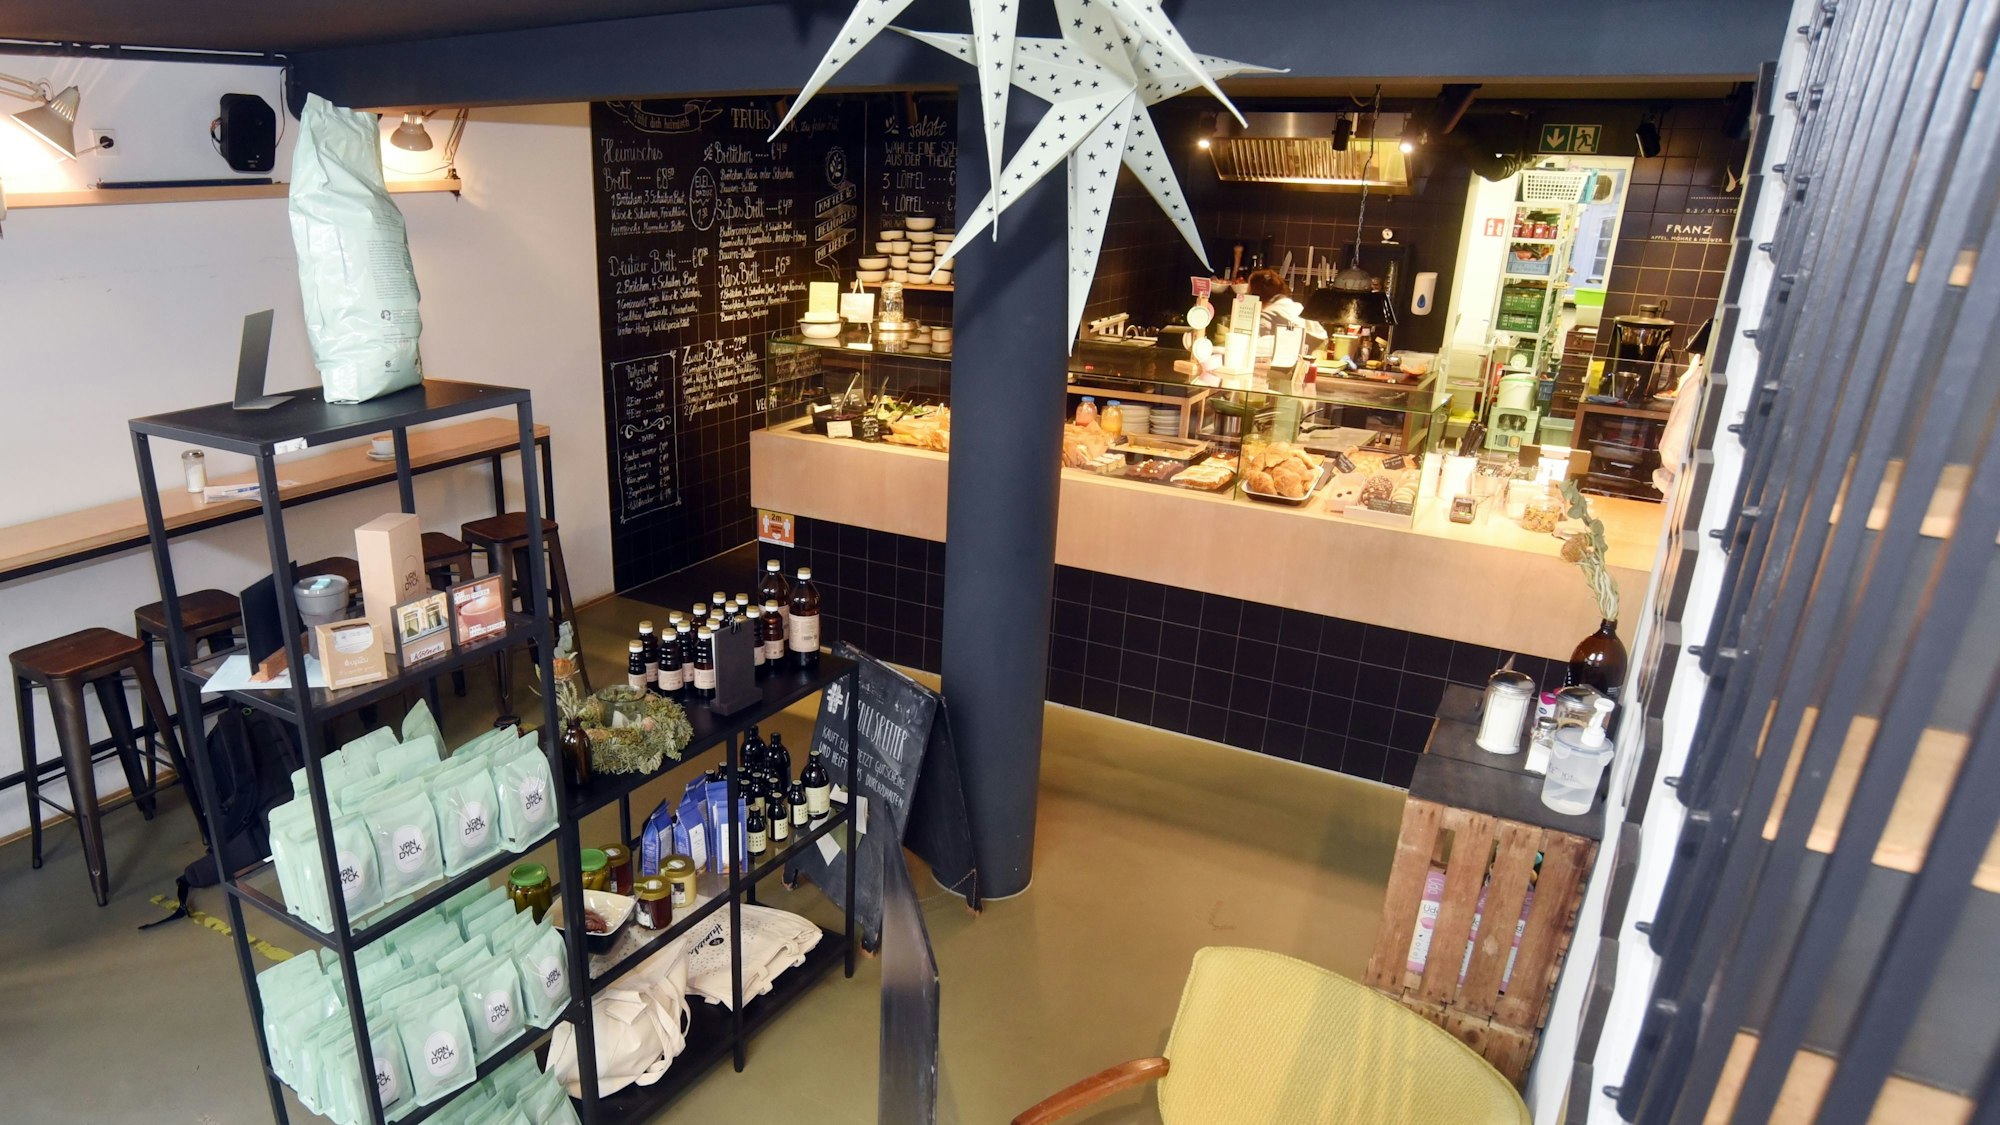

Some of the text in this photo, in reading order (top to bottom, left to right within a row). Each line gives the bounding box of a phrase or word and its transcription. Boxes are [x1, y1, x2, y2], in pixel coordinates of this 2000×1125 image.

[601, 138, 663, 164] Heimisches
[714, 141, 753, 164] Brettchen
[917, 141, 937, 156] EINE
[885, 154, 901, 167] AUS
[904, 154, 921, 167] DER
[602, 167, 632, 192] Brett
[760, 166, 772, 179] oder
[882, 170, 925, 190] 3 LÖFFEL
[716, 195, 766, 223] Süßes Brett
[881, 194, 925, 213] 4 LÖFFEL
[1665, 224, 1712, 235] FRANZ
[608, 249, 677, 277] Deutzer Brett
[717, 260, 761, 289] Käse Brett
[616, 282, 622, 294] 2
[743, 286, 749, 297] 2
[634, 374, 653, 392] Brot
[683, 405, 689, 416] 2
[755, 394, 778, 412] VEGAN
[771, 513, 782, 522] 2m
[405, 569, 417, 581] VAN
[404, 576, 420, 591] DYCK
[822, 725, 839, 747] KAUFT
[874, 760, 906, 790] GUTSCHEINE
[818, 740, 831, 758] UND
[831, 749, 848, 771] HELFT
[865, 774, 905, 808] DURCHZUHALTEN
[525, 789, 540, 803] VAN
[525, 795, 543, 810] DYCK
[464, 820, 485, 836] DYCK
[466, 815, 482, 829] VAN
[399, 838, 416, 854] VAN
[399, 843, 423, 860] DYCK
[341, 870, 360, 885] YCK
[1428, 878, 1442, 895] Udo
[1423, 904, 1439, 914] Ud
[546, 968, 558, 981] VAN
[546, 971, 561, 988] DYCK
[491, 1007, 510, 1023] DYCK
[431, 1044, 449, 1058] VAN
[431, 1049, 454, 1065] DYCK
